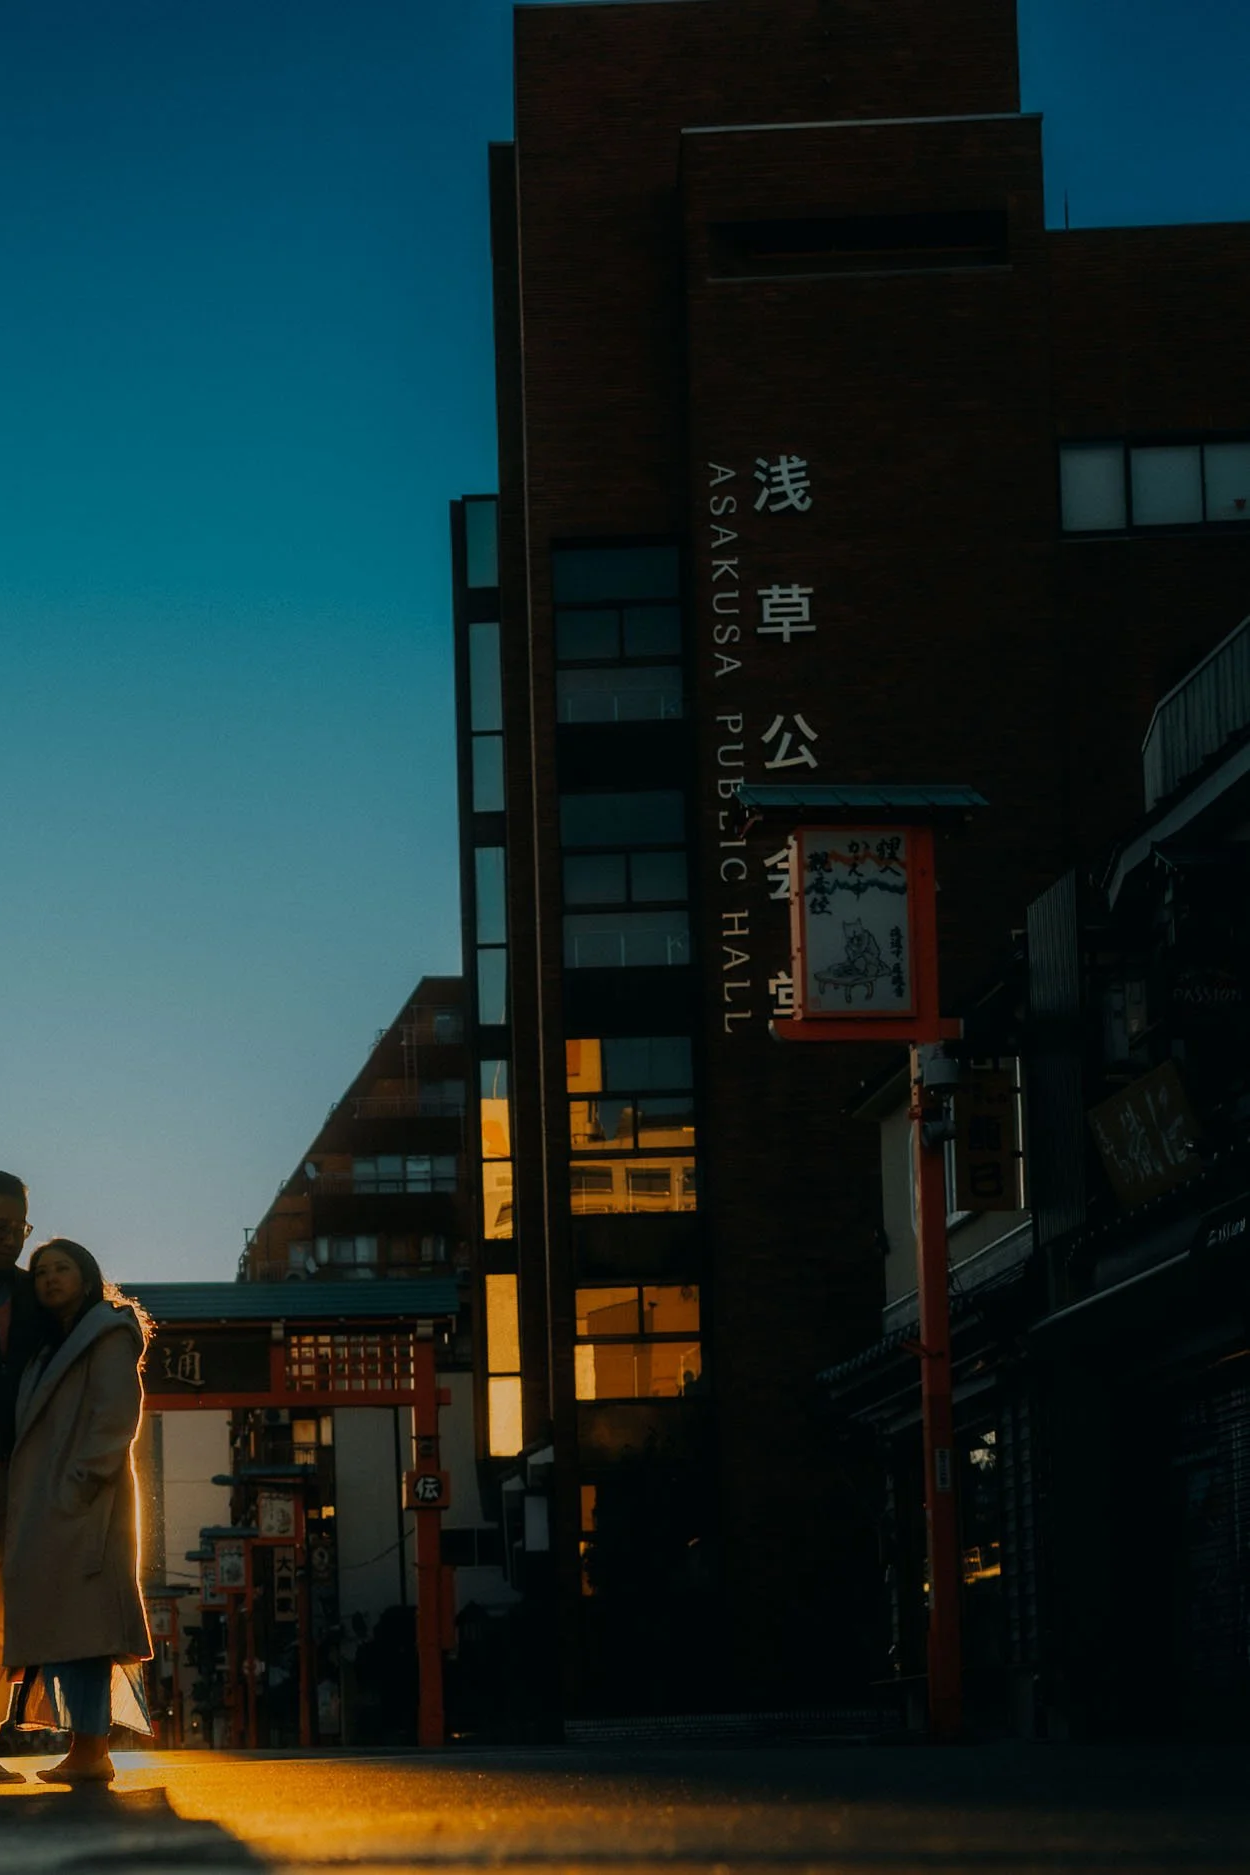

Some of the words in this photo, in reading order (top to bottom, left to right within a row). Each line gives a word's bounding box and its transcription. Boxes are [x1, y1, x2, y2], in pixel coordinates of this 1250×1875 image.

[707, 461, 743, 679] ASAKUSA
[715, 712, 748, 883] PUBLIC
[720, 908, 753, 1034] HALL
[1172, 985, 1243, 1004] PASSION
[162, 1339, 206, 1388] 通
[414, 1476, 441, 1502] 伝
